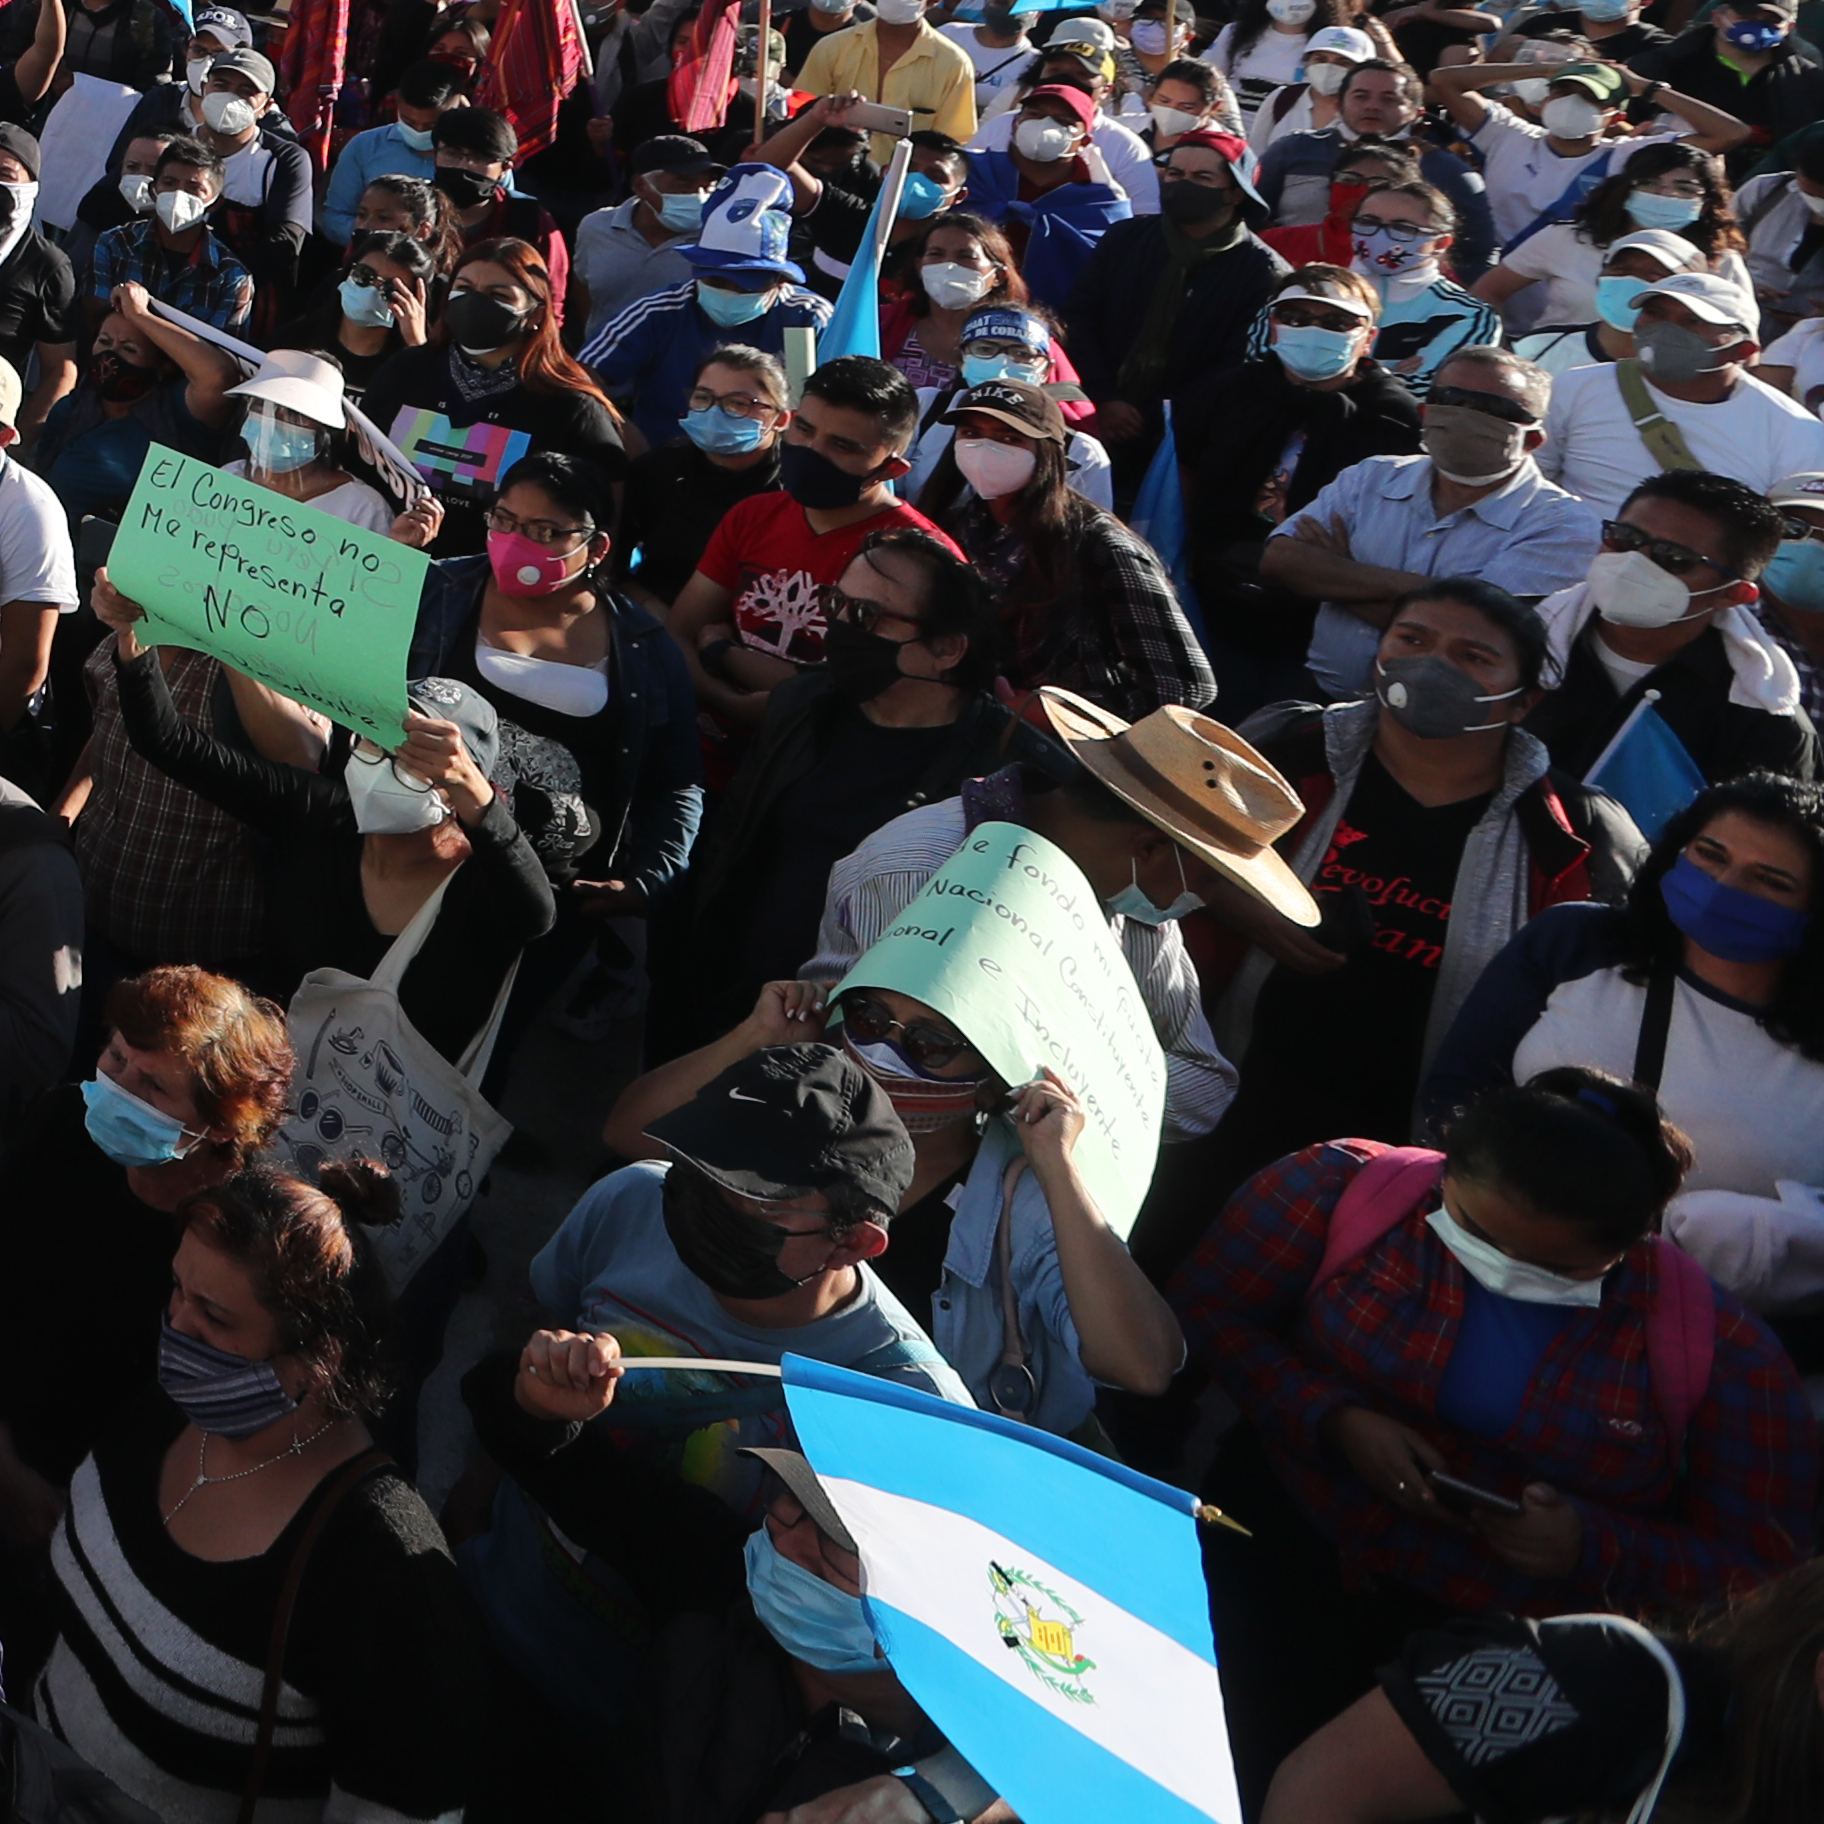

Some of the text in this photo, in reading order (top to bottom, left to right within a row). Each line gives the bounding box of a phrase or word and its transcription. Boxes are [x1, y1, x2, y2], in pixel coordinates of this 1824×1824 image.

[970, 386, 1025, 406] NIKE
[150, 459, 380, 571] El Congreso no
[446, 494, 470, 508] LOVE
[141, 502, 345, 618] Me representa
[204, 585, 270, 639] NO
[925, 878, 1054, 958] Nacional
[1007, 843, 1086, 932] fondo
[339, 1075, 382, 1111] SHOP SMALL
[978, 957, 1004, 980] e
[1013, 983, 1121, 1162] Incluyente
